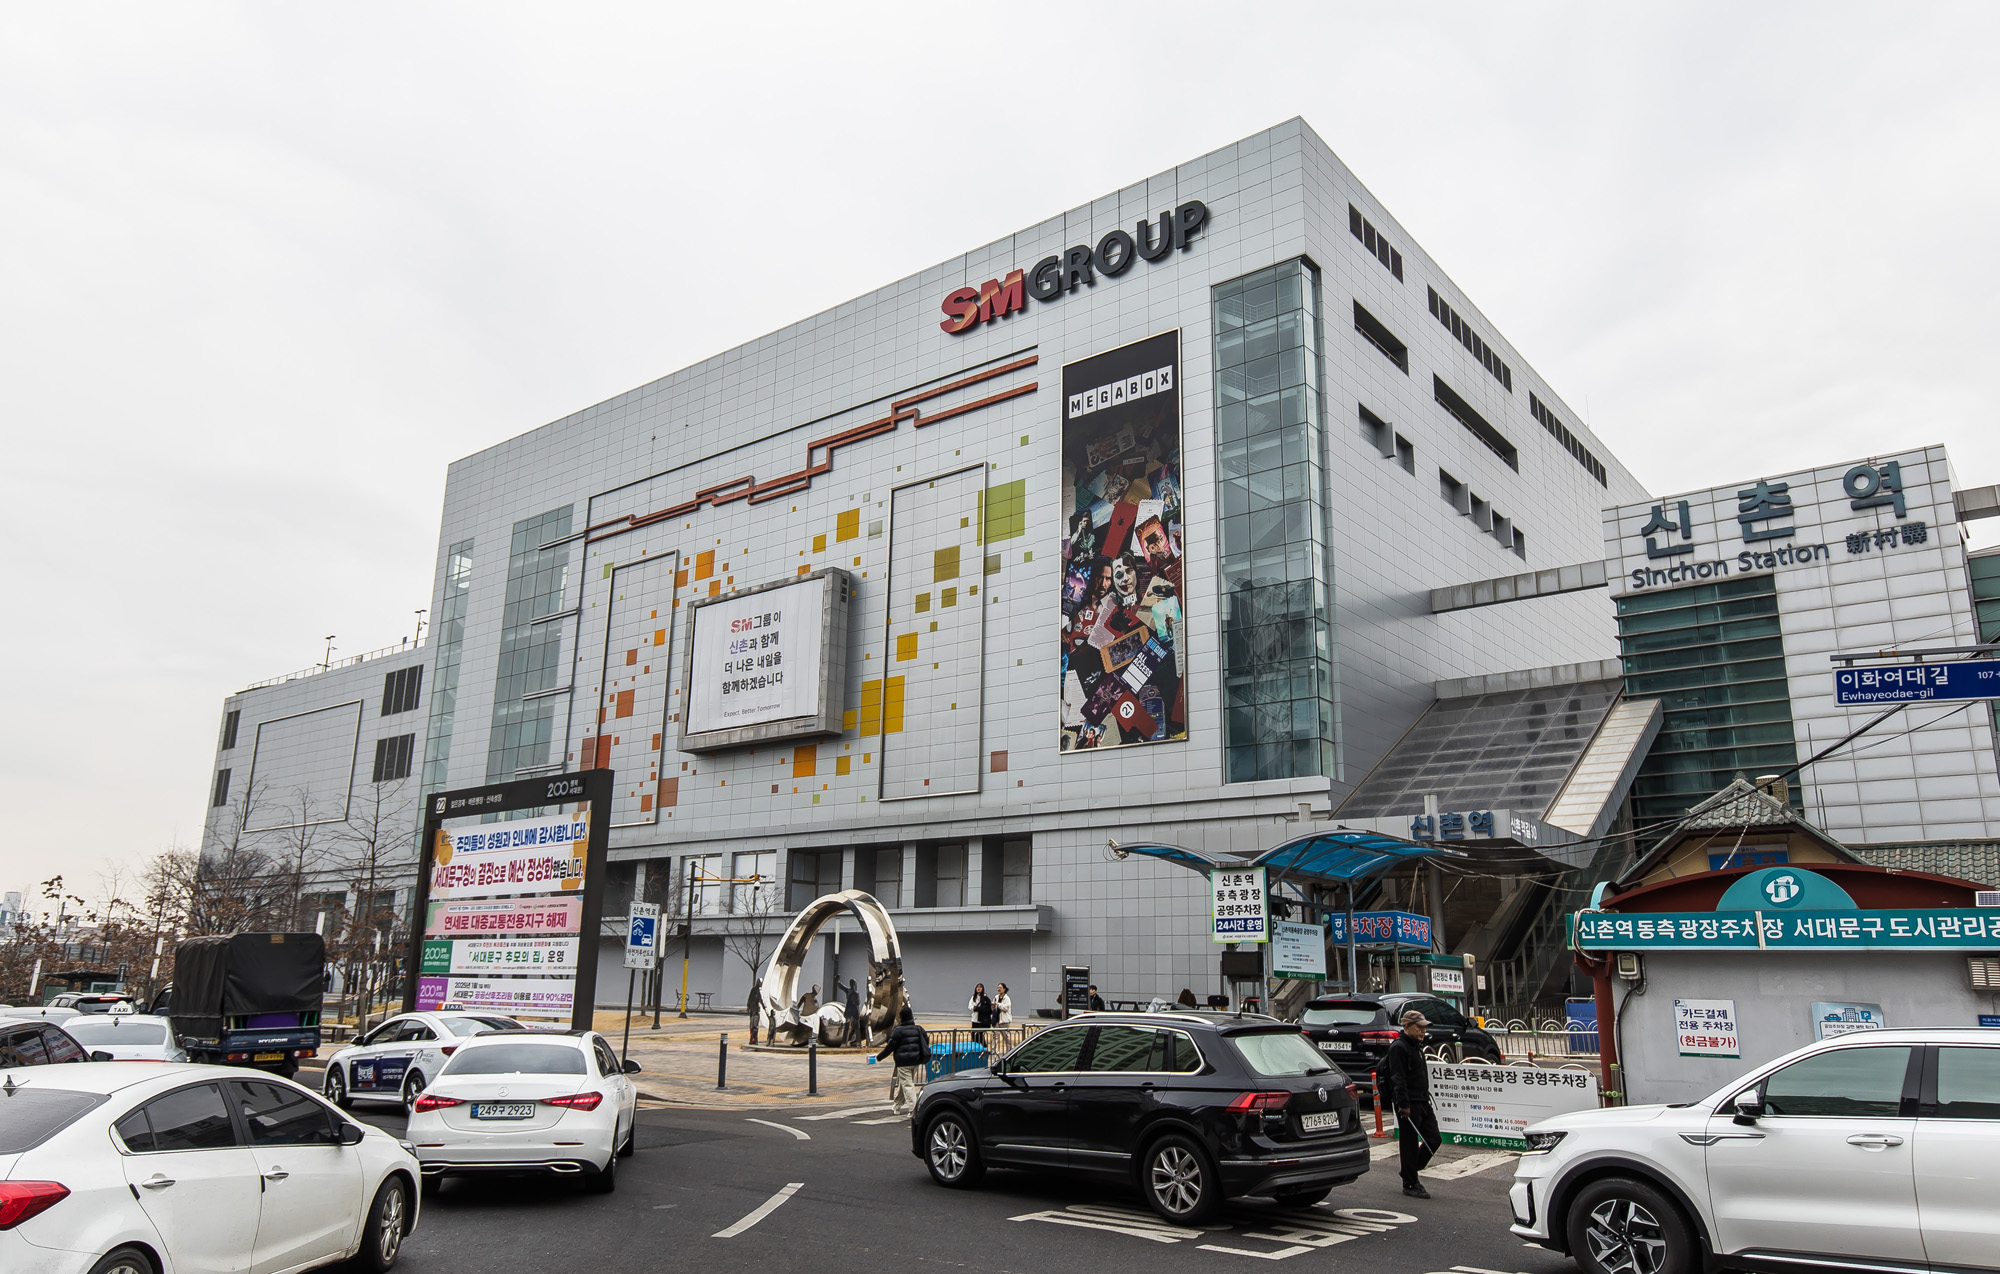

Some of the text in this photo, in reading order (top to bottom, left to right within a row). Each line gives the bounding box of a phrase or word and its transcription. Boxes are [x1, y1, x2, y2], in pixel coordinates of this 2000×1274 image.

[1071, 371, 1169, 413] MEGABOX
[1641, 461, 1907, 559] 신촌역
[1846, 522, 1927, 553] 新村驛
[1632, 543, 1829, 589] Sinchon Station
[729, 631, 779, 654] 신촌과 함께
[725, 661, 733, 674] 더
[757, 651, 782, 668] 내일을
[1136, 652, 1147, 663] ALL
[1133, 657, 1152, 677] ACCESS
[722, 671, 783, 694] 함께하겠습니다
[1841, 666, 1994, 689] 이화여대길 107
[1842, 688, 1934, 701] Ewhayeodae-gil
[742, 707, 756, 715] Better
[757, 703, 781, 713] Tomorrow
[1121, 703, 1133, 716] 21
[547, 781, 568, 797] 200
[1410, 811, 1494, 840] 신촌역
[457, 834, 486, 852] 주민들의
[487, 831, 511, 849] 성원과
[512, 828, 537, 846] 인내에
[539, 822, 586, 844] 감사합니다!
[434, 865, 477, 888] 서대문구청의
[478, 861, 506, 885] 결정으로
[508, 859, 525, 883] 예산
[1222, 874, 1254, 886] 신촌역
[1216, 888, 1261, 901] 동측광장
[633, 906, 656, 915] 신촌역로
[1217, 904, 1261, 916] 공영주차장
[444, 912, 567, 930] 연세로 대중교통전용지구 해제
[1217, 919, 1262, 931] 24시간 운영
[1335, 918, 1342, 939] 공영
[1579, 920, 1633, 939] 신촌역
[1794, 917, 1884, 938] 서대문구
[1403, 918, 1429, 942] 주차장
[424, 947, 440, 960] 200
[505, 951, 529, 963] 추모의
[548, 950, 564, 963] 운영
[420, 985, 436, 997] 200
[453, 991, 474, 999] 서대문구
[514, 992, 530, 1000] 이용료
[1682, 1008, 1727, 1019] 카드결제
[1679, 1020, 1734, 1031] 전용 주차장
[1680, 1035, 1736, 1048] (현금불가)
[1431, 1067, 1587, 1088] 신촌역동측광장 공영주차장
[479, 1105, 532, 1115] 249구 2923
[1304, 1113, 1339, 1128] 276주 8204
[1490, 1138, 1527, 1148] 서대문구도시
